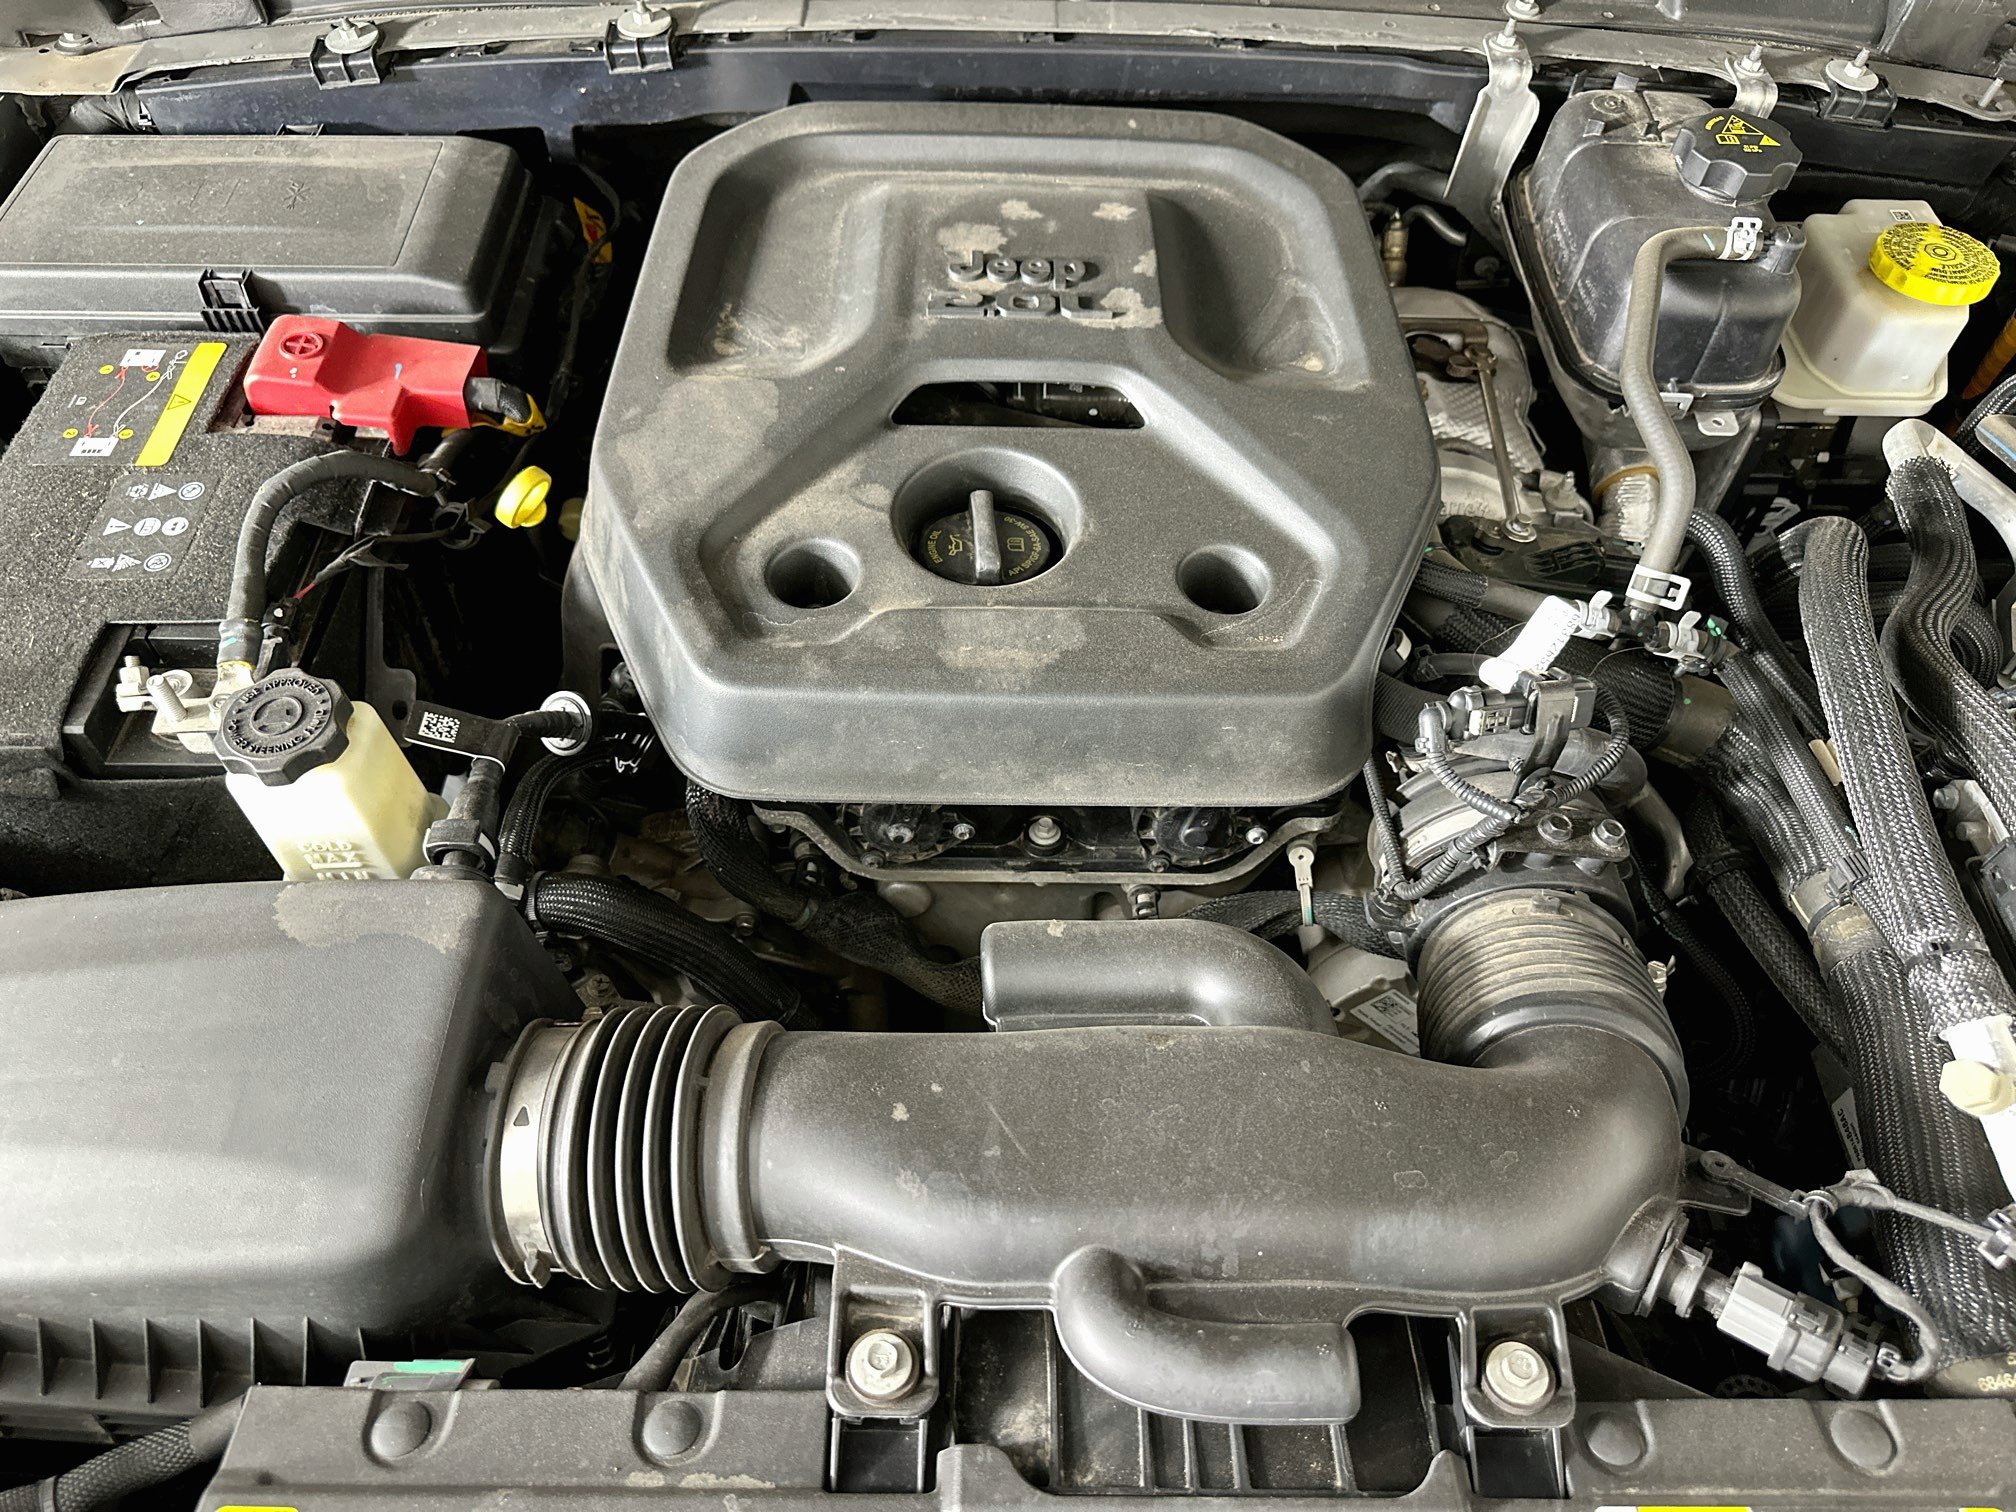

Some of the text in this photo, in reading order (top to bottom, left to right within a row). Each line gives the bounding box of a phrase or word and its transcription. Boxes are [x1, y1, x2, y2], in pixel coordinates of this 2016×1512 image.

[948, 250, 1087, 290] Jeep
[925, 291, 1115, 319] 2.0L
[927, 530, 944, 564] ENGINE OIL
[1008, 566, 1025, 577] API
[240, 678, 325, 704] USE APPROVED
[228, 719, 252, 750] POWER
[249, 735, 305, 755] STEERING
[1977, 1373, 2016, 1391] 6846
